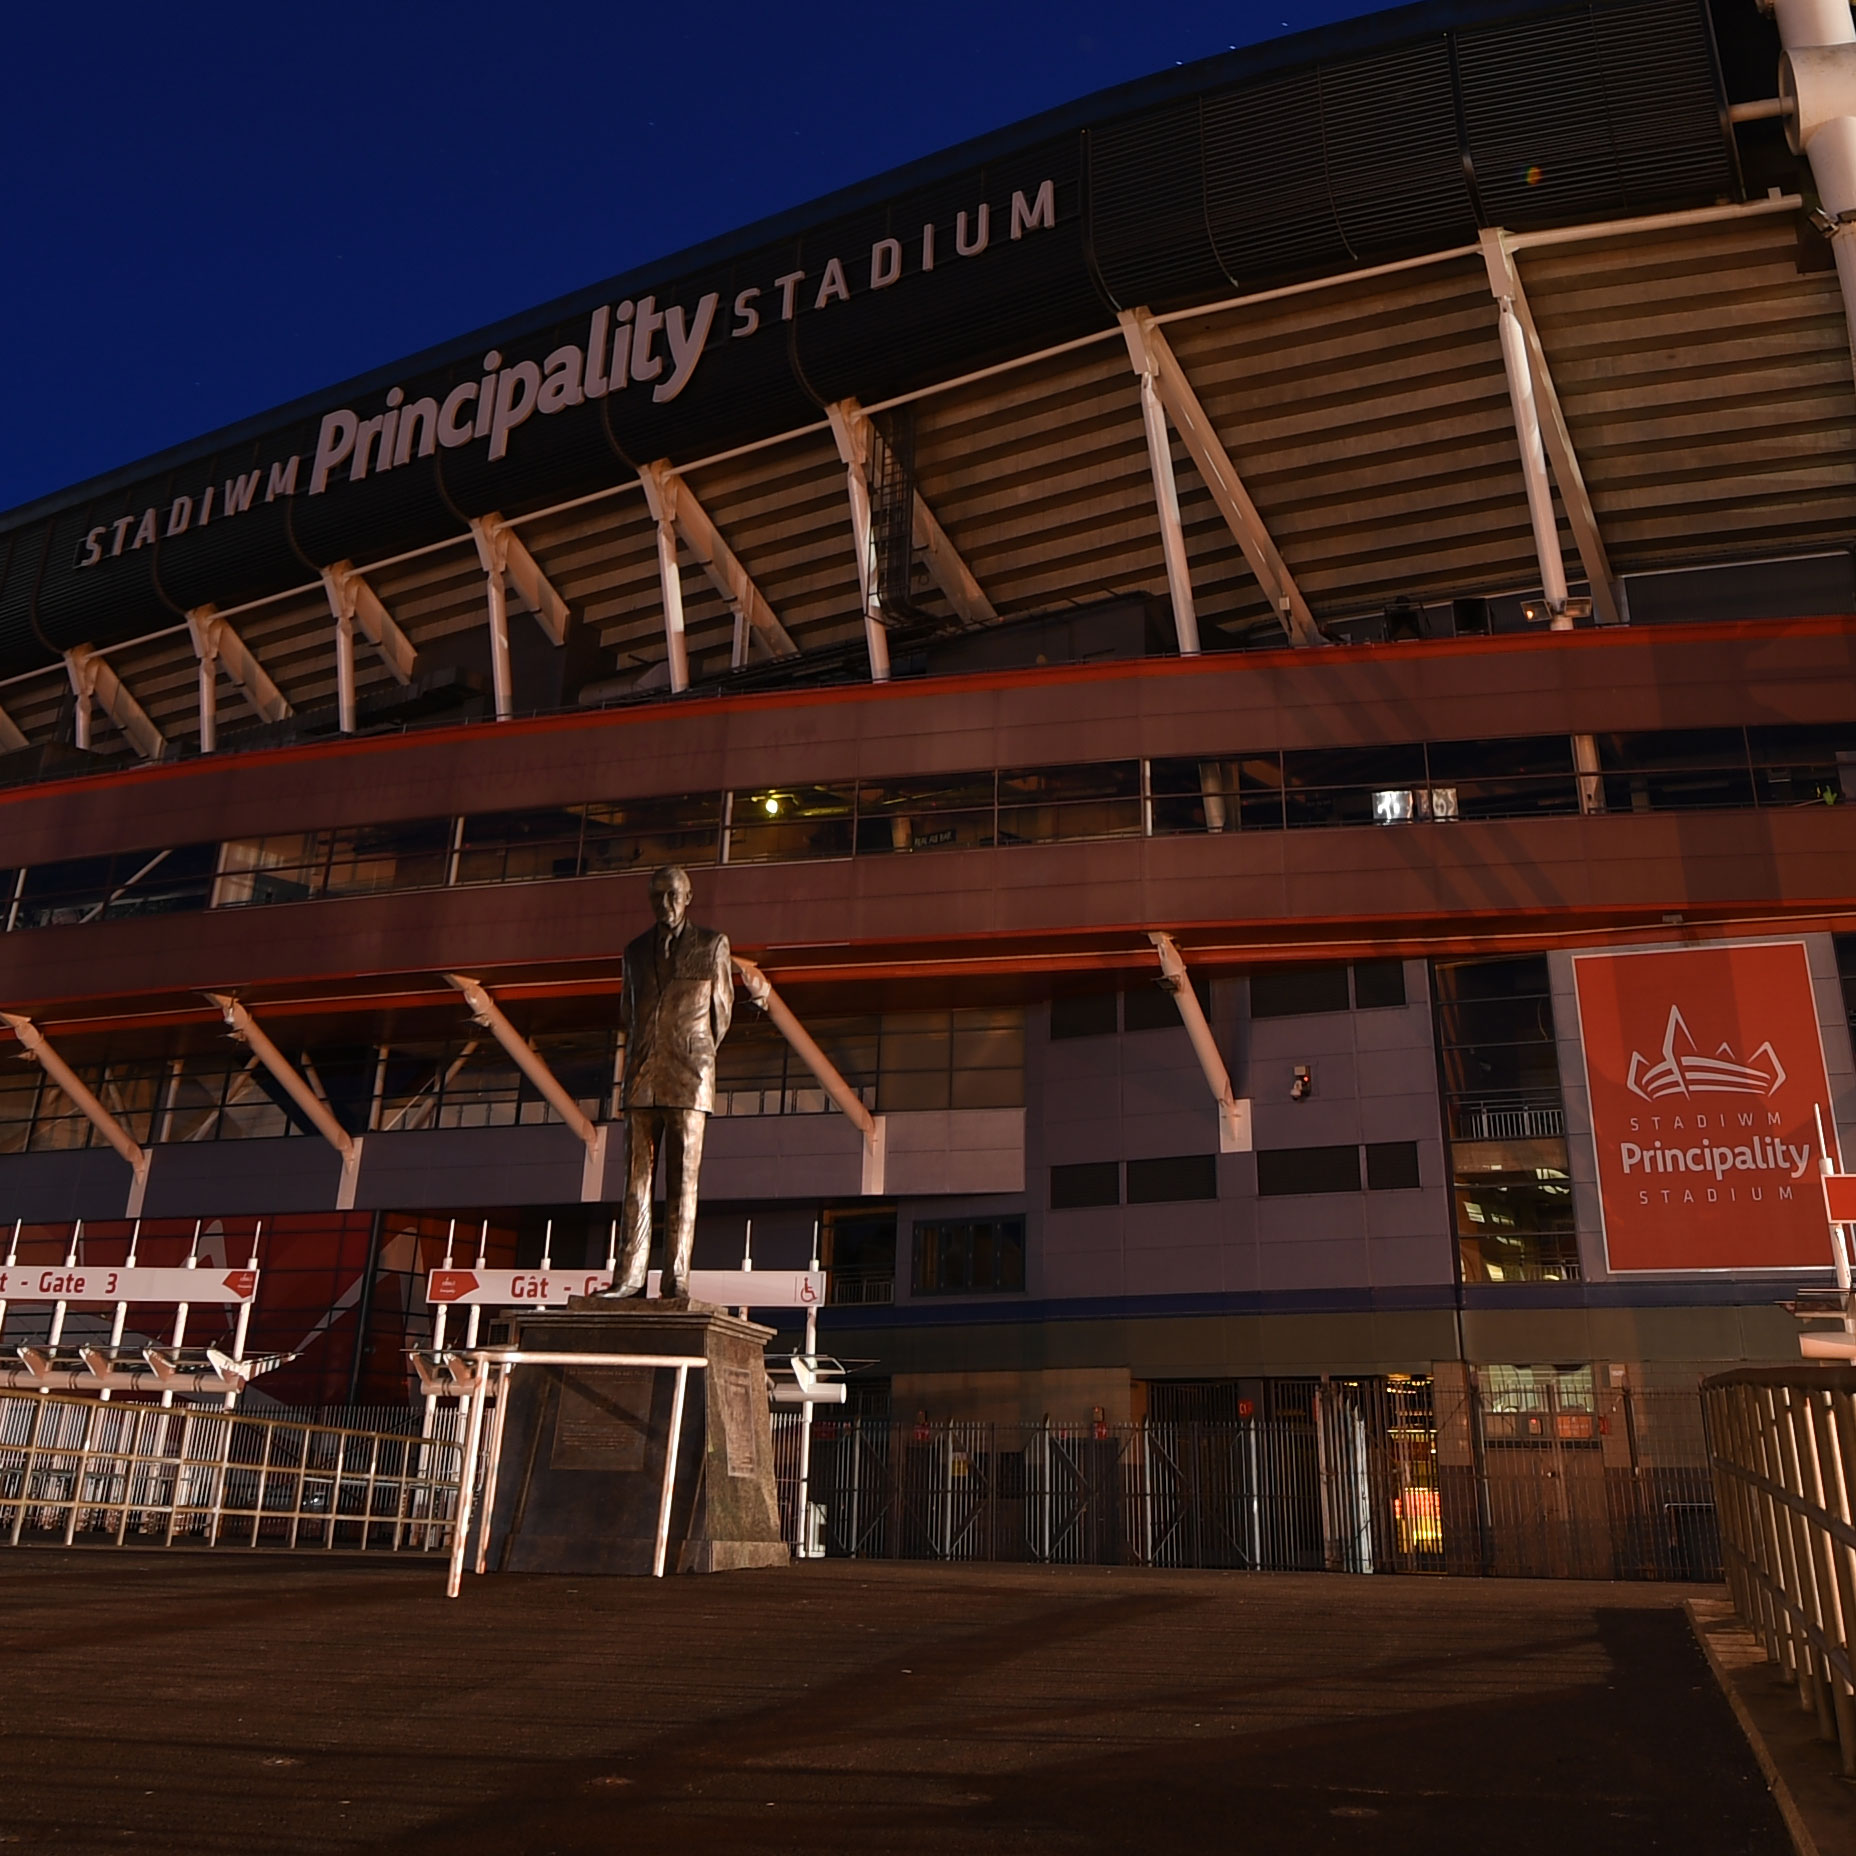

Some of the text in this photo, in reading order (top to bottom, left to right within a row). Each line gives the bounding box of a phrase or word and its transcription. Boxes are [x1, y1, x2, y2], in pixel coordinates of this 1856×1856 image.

[80, 181, 1055, 566] STADIWM Principality STADIUM
[1630, 1112, 1781, 1131] STADIWM
[1620, 1135, 1810, 1181] Principality
[1639, 1187, 1793, 1205] STADIUM
[38, 1271, 87, 1295] Gate
[105, 1271, 119, 1295] 3
[510, 1275, 549, 1299] Gât
